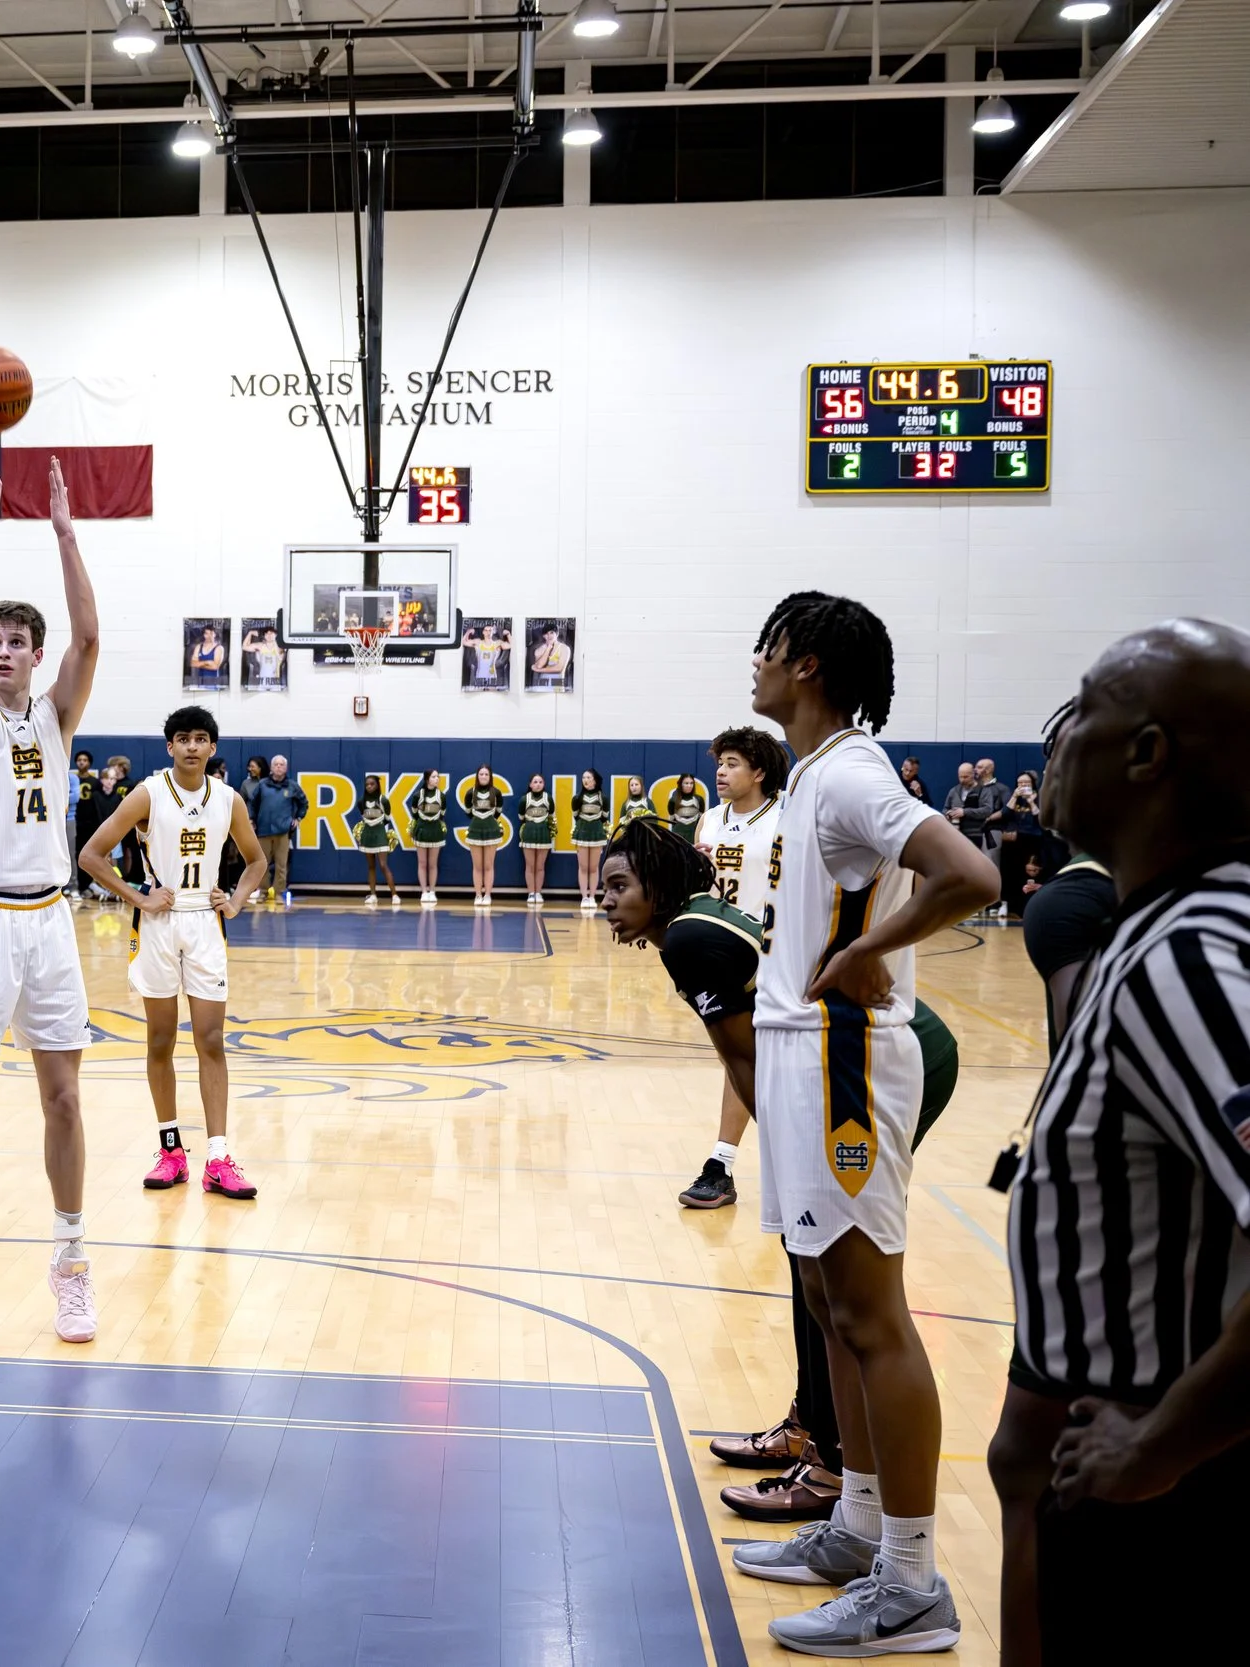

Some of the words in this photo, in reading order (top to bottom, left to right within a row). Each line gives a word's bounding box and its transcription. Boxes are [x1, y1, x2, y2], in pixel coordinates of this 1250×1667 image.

[230, 372, 353, 397] MORRIS
[407, 369, 554, 394] SPENCER
[819, 369, 861, 384] HOME
[878, 369, 959, 400] 44.6
[989, 366, 1047, 382] VISITOR
[824, 388, 863, 418] 56
[907, 406, 928, 415] POSS
[1002, 386, 1042, 416] 48
[288, 401, 493, 427] GYMASIUM
[898, 415, 937, 427] PERIOD
[940, 410, 958, 435] 4
[833, 423, 869, 435] BONUS
[986, 421, 1023, 433] BONUS
[828, 442, 862, 454] FOULS
[891, 442, 931, 453] PLAYER
[938, 441, 972, 452] FOULS
[993, 440, 1027, 452] FOULS
[842, 453, 861, 479] 2
[1010, 452, 1027, 478] 5
[419, 488, 461, 523] 35
[385, 656, 426, 664] WRESTLING
[80, 783, 91, 800] G
[15, 788, 47, 823] 14
[180, 862, 201, 889] 11
